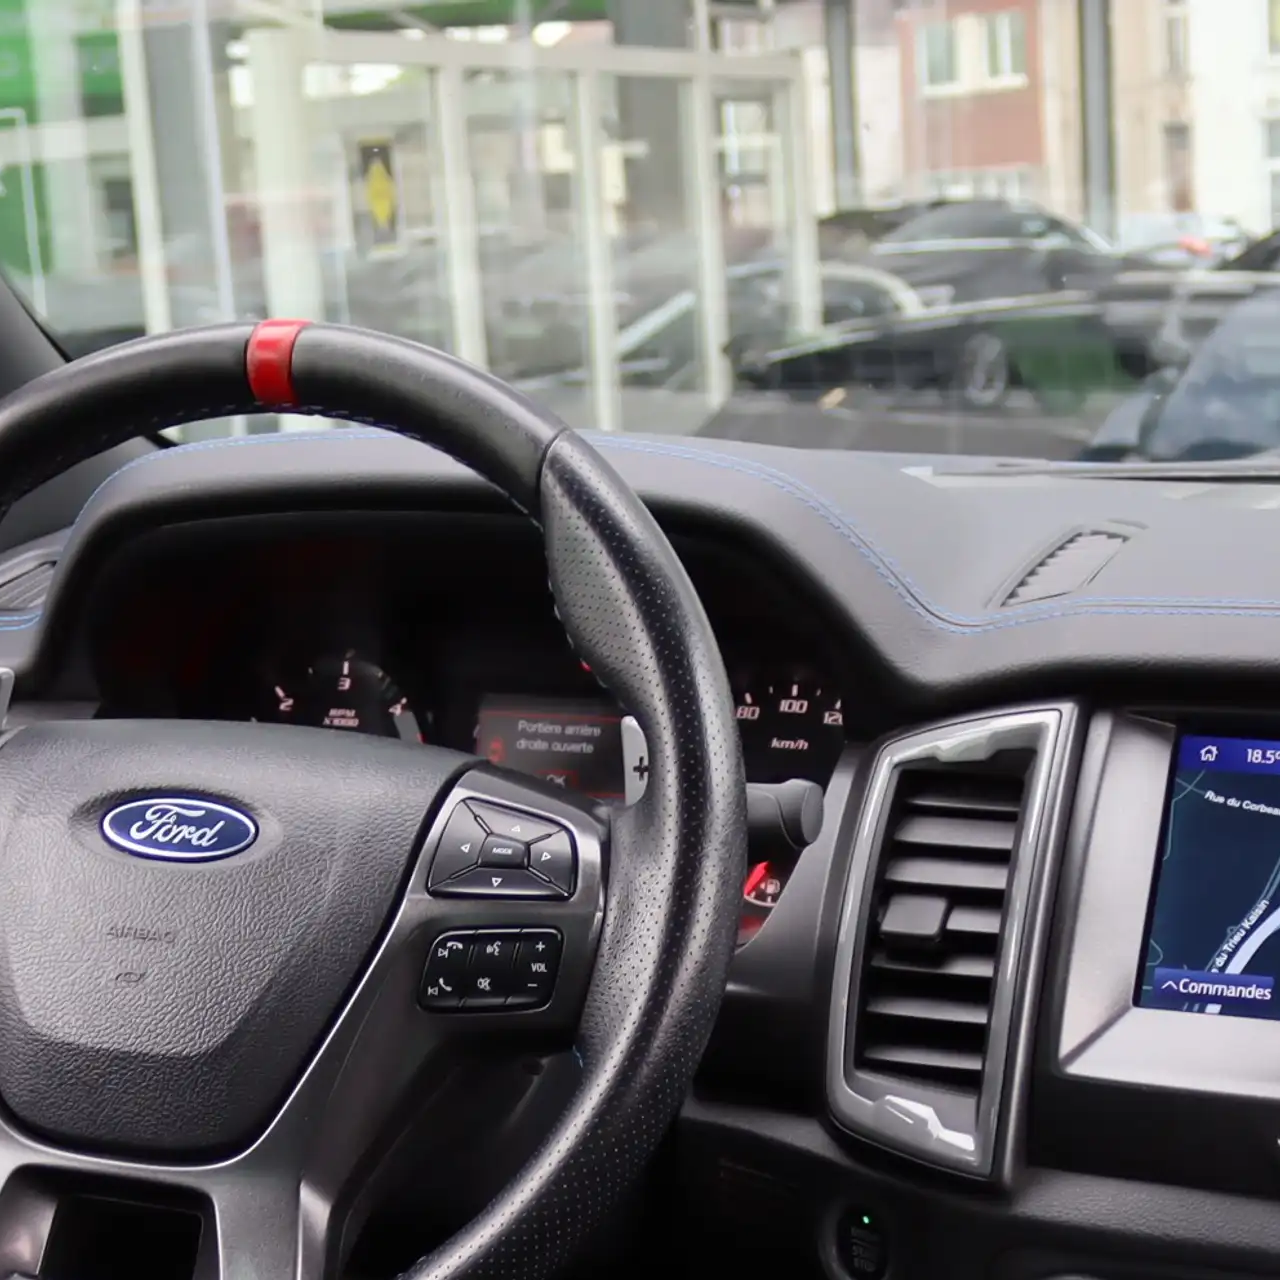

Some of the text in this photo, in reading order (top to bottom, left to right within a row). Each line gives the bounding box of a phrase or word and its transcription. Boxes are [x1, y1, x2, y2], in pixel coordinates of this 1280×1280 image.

[338, 678, 351, 691] 3
[279, 698, 294, 711] 2
[779, 699, 809, 714] 100
[516, 738, 595, 754] droite ouverte
[771, 737, 809, 750] km/h
[1204, 789, 1225, 804] Rue
[1226, 795, 1241, 808] du
[129, 803, 226, 848] Ford
[1214, 953, 1228, 968] du
[1222, 928, 1247, 953] Trieu
[530, 962, 548, 973] VOL
[1178, 978, 1272, 1001] Commandes
